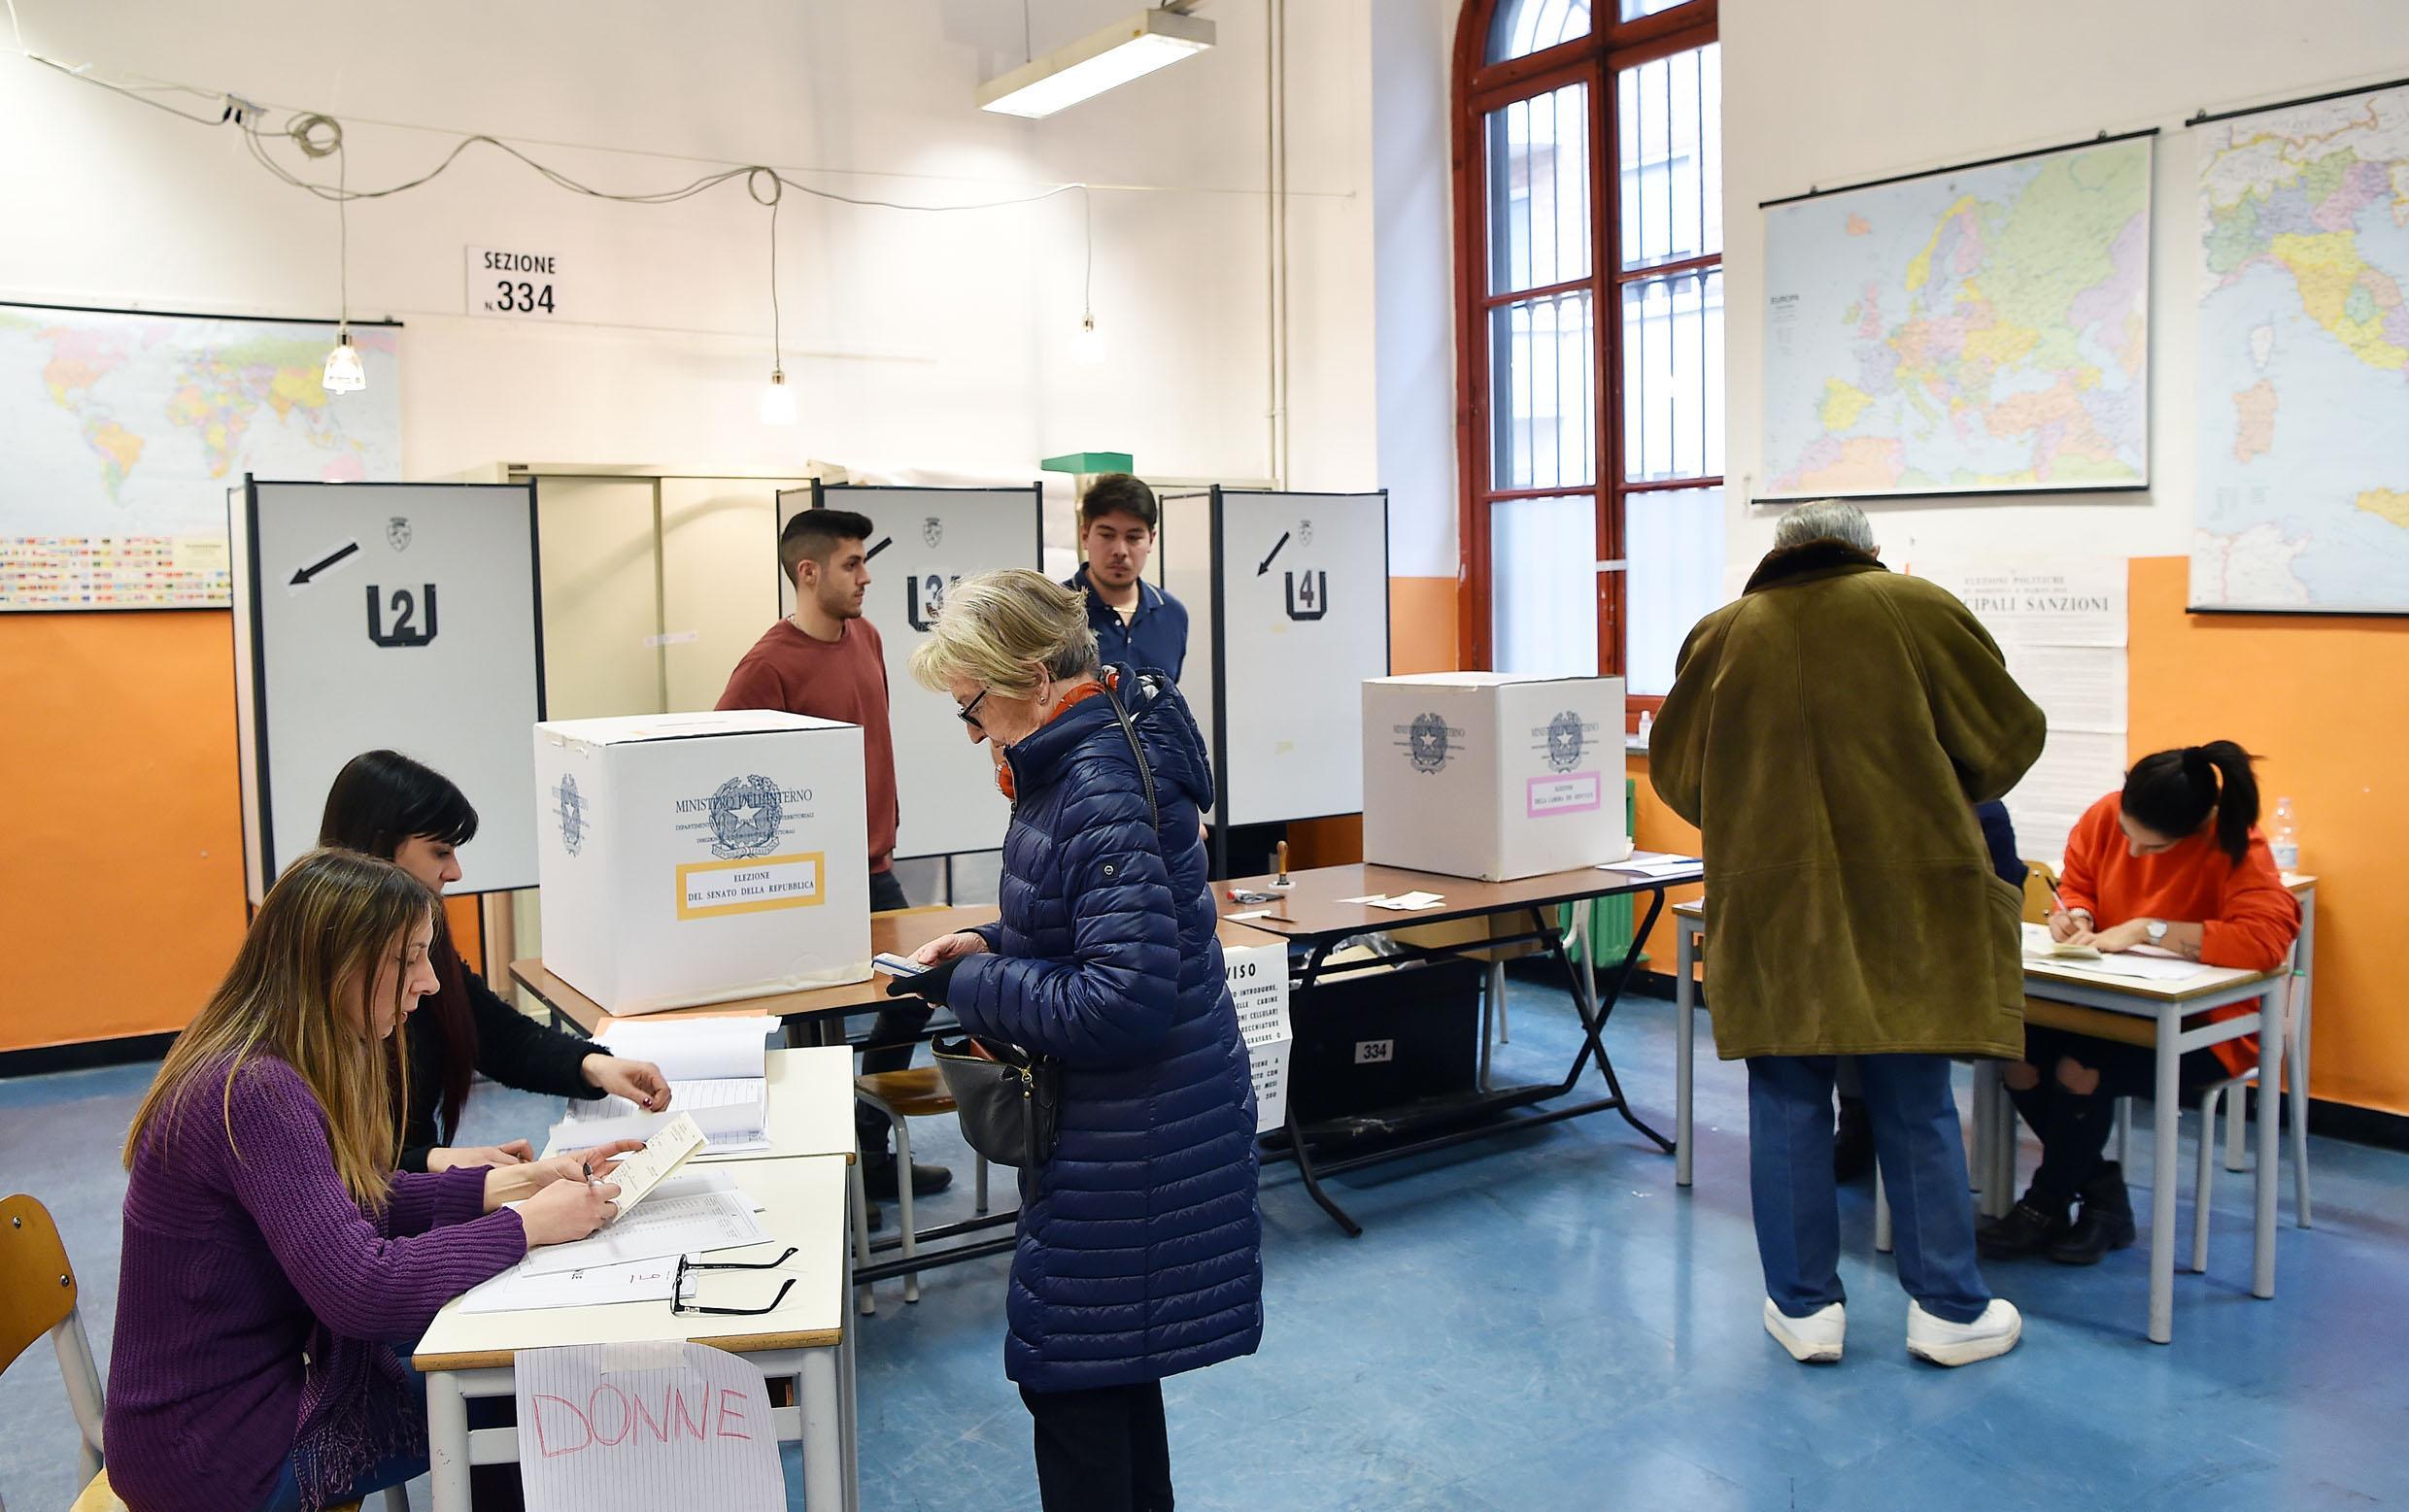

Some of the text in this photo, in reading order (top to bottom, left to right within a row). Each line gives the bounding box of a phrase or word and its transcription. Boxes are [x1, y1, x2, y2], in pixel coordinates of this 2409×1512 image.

[484, 252, 556, 274] SEZIONE
[497, 281, 556, 314] 334
[2026, 597, 2109, 613] SANZIONI
[733, 871, 770, 883] ELEZIONE
[688, 880, 814, 901] DEL SENATO DELLA REPUBBLICA
[1225, 962, 1256, 981] VISO
[1237, 995, 1278, 1010] ELLE CABINE
[1249, 1008, 1278, 1020] CELLULARI
[1240, 1020, 1279, 1033] RECCHIATURE
[1247, 1033, 1272, 1045] GRAFARE
[1363, 1043, 1386, 1059] 334
[532, 1380, 752, 1458] DONNE
